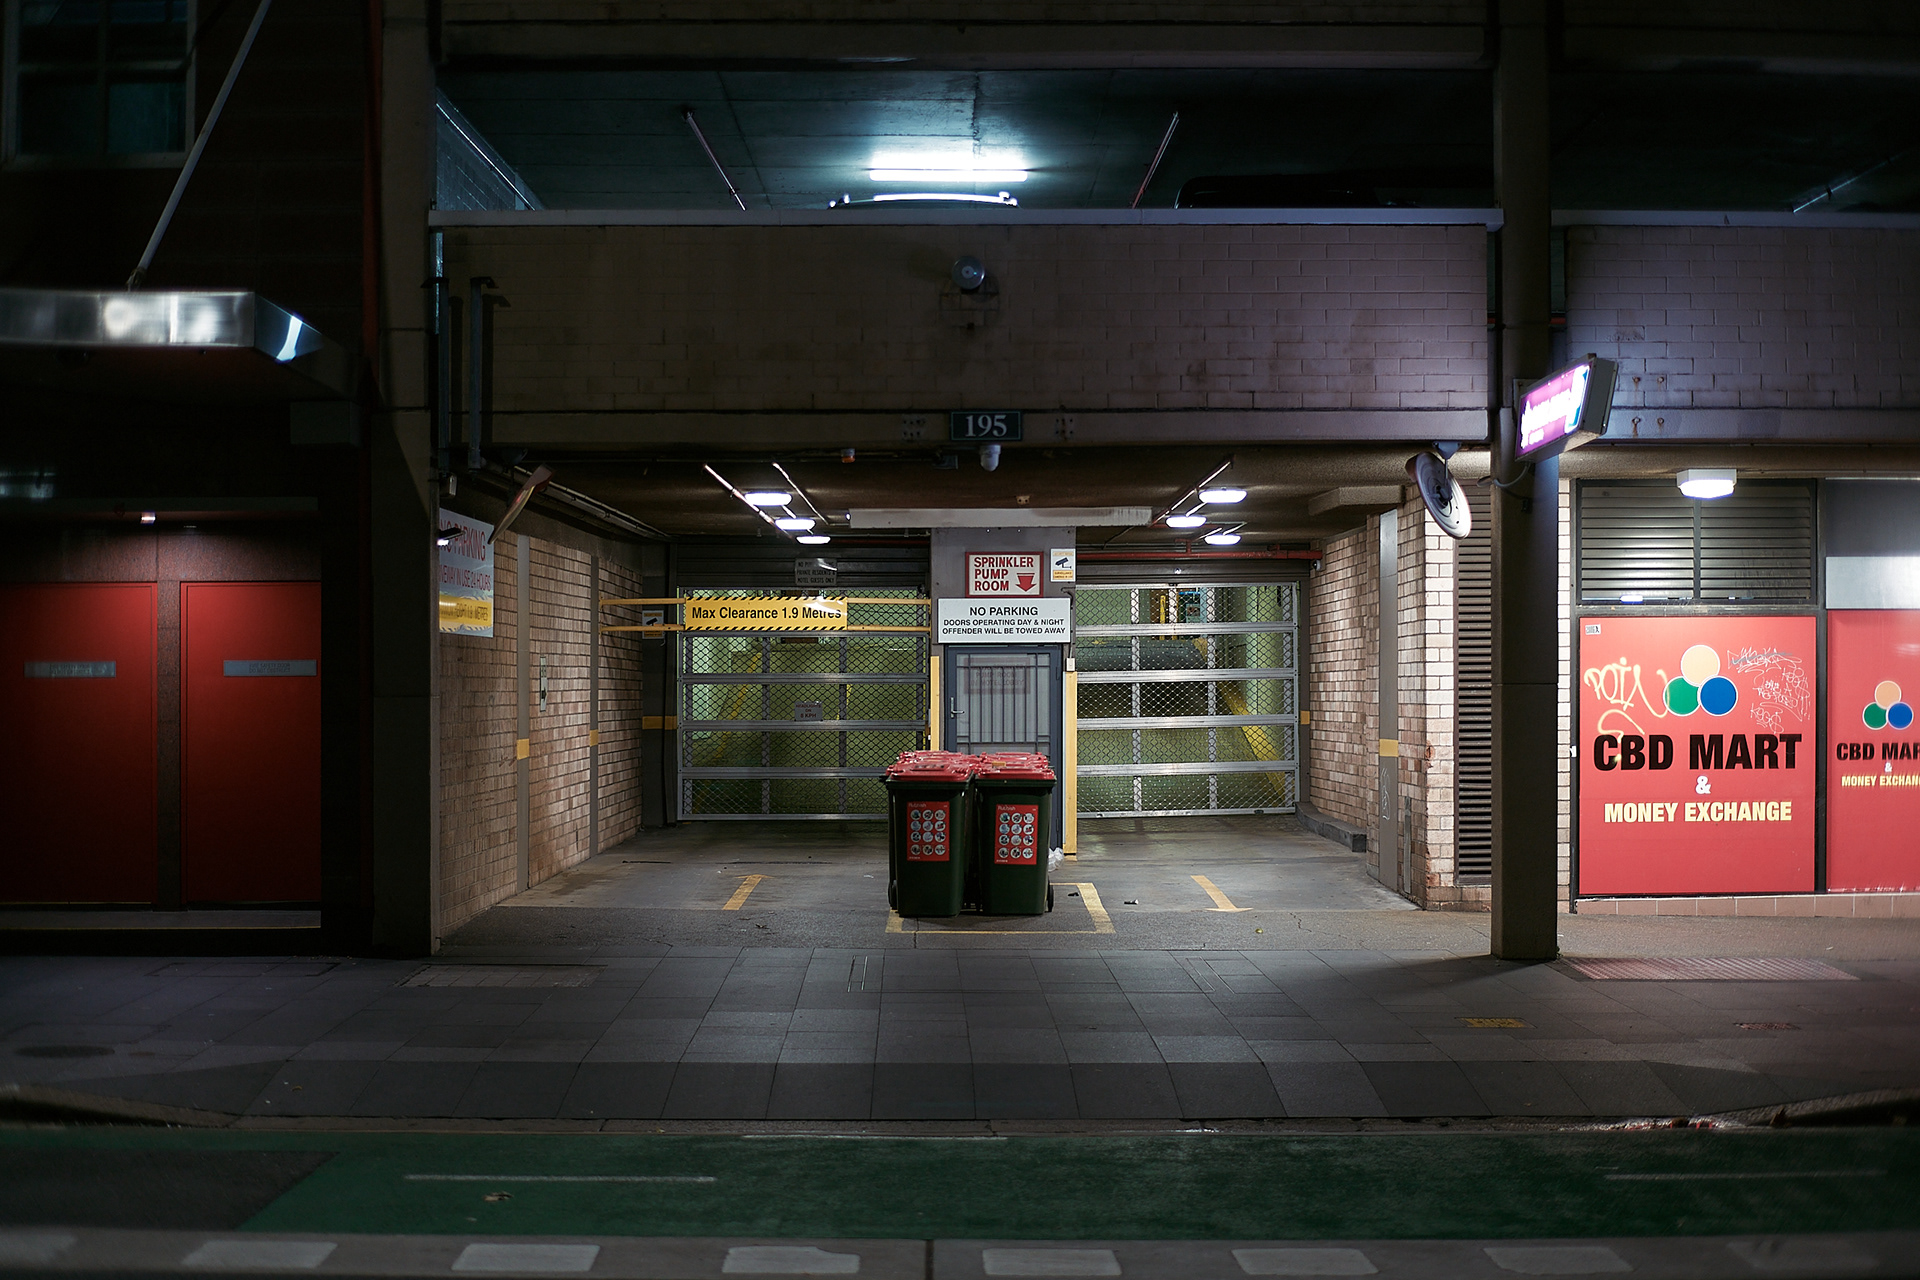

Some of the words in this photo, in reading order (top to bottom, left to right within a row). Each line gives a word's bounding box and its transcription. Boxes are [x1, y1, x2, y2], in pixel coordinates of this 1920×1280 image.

[965, 414, 1008, 437] 195
[974, 556, 1034, 568] SPRINKLER
[974, 568, 1008, 579] PUMP
[974, 580, 1009, 591] ROOM
[692, 607, 716, 618] Max
[719, 606, 778, 619] Clearance
[782, 607, 798, 618] 1.9
[802, 607, 841, 618] Metres
[970, 607, 986, 616] NO
[990, 607, 1038, 616] PARKING
[1593, 734, 1673, 771] CBD
[1690, 734, 1802, 770] MART
[1836, 742, 1874, 760] CBD
[1885, 762, 1892, 772] &
[1696, 776, 1711, 794] &
[1842, 776, 1877, 786] MONEY
[1604, 802, 1677, 823] MONEY
[1684, 801, 1792, 822] EXCHANGE
